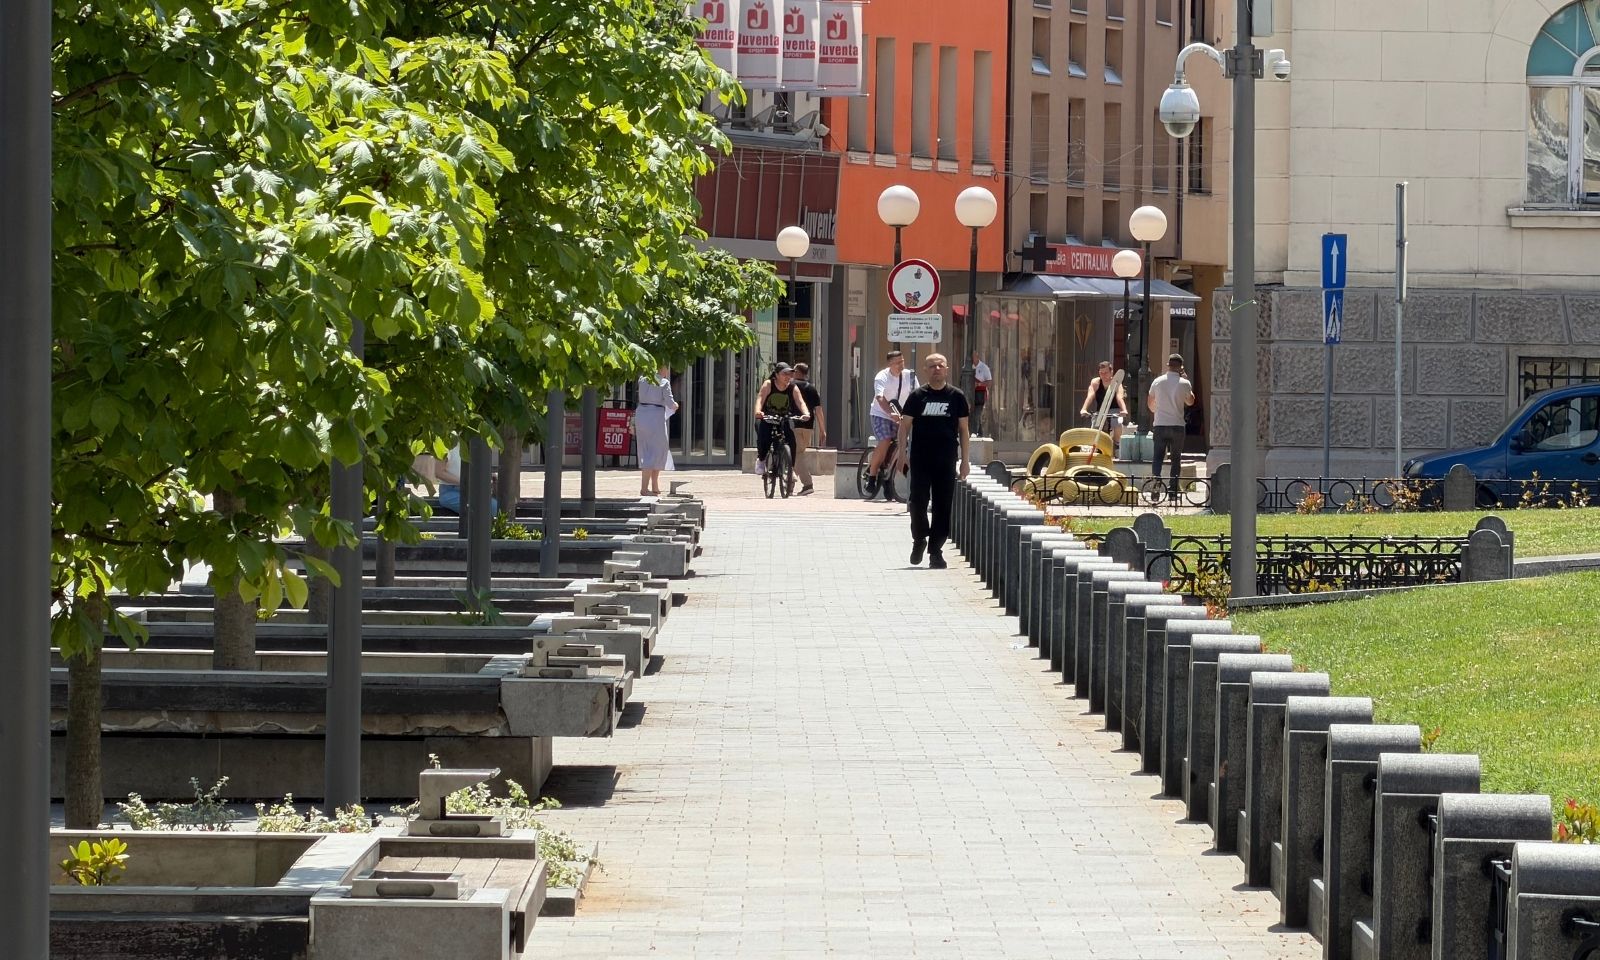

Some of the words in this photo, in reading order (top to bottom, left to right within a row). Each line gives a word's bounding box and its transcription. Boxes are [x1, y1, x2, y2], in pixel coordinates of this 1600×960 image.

[737, 33, 780, 47] Juventa
[1071, 251, 1109, 271] CENTRALNA
[921, 402, 949, 416] NIKE
